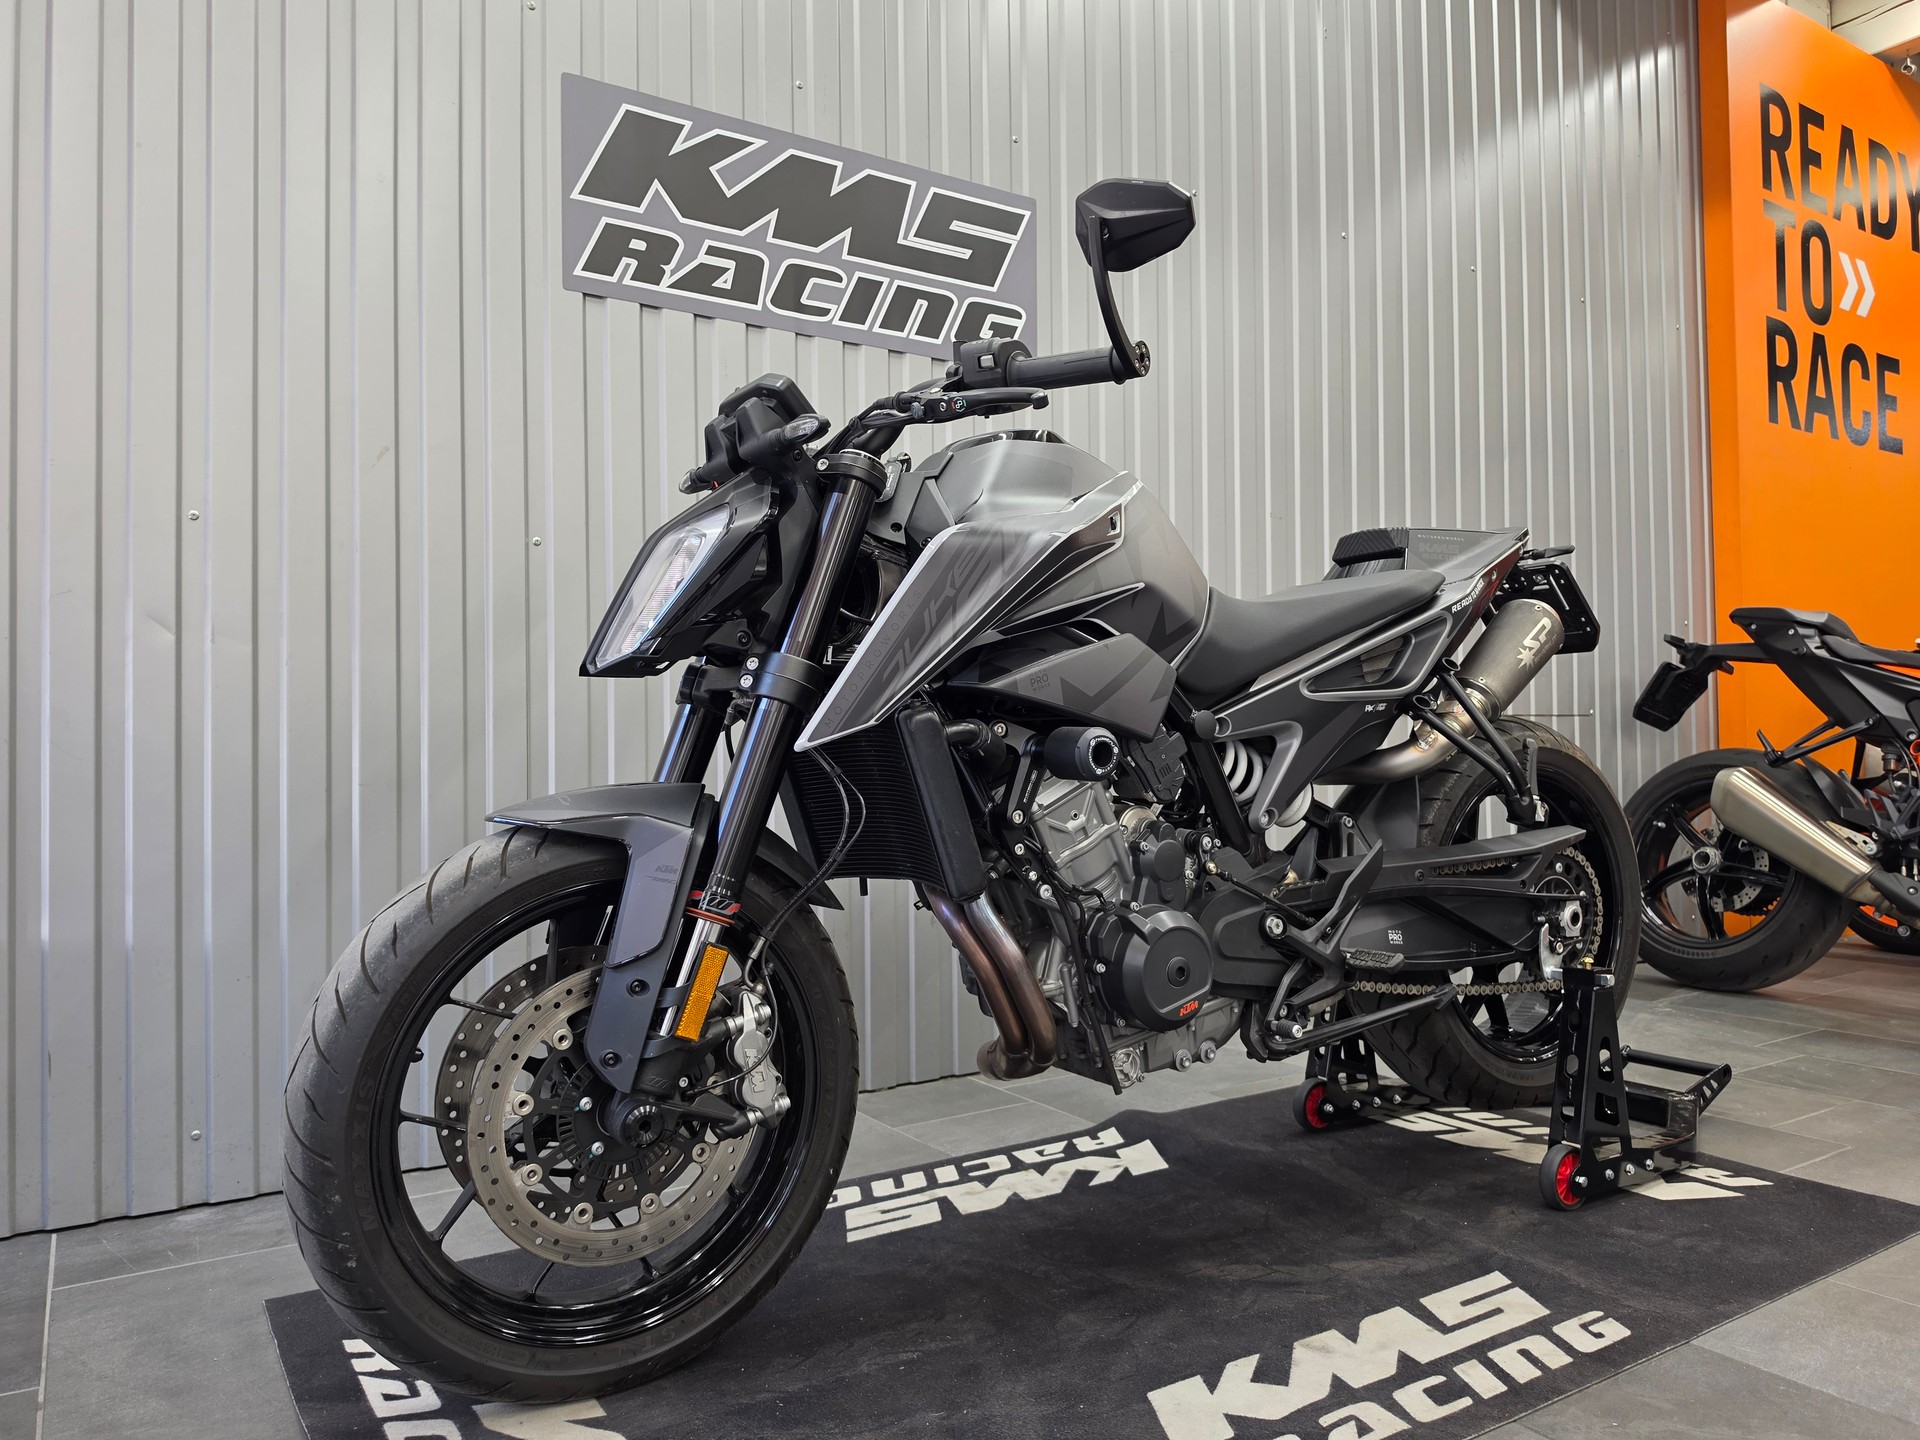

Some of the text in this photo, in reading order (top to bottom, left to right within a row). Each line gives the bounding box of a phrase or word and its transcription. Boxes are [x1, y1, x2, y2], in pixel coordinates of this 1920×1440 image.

[569, 103, 1031, 292] KMS
[1759, 82, 1920, 253] READY
[573, 216, 1027, 344] RACING
[1762, 198, 1833, 326] TO
[1766, 315, 1903, 455] RACE
[825, 590, 923, 730] MOTOPROWORKS
[1451, 596, 1473, 614] READY
[1029, 673, 1049, 687] PRO
[1388, 933, 1403, 941] PRO
[1179, 999, 1199, 1016] KTM
[351, 1077, 379, 1232] MAXXIS
[845, 1138, 1170, 1243] KMS
[1146, 1269, 1551, 1440] KMS
[1272, 1310, 1632, 1440] ACING
